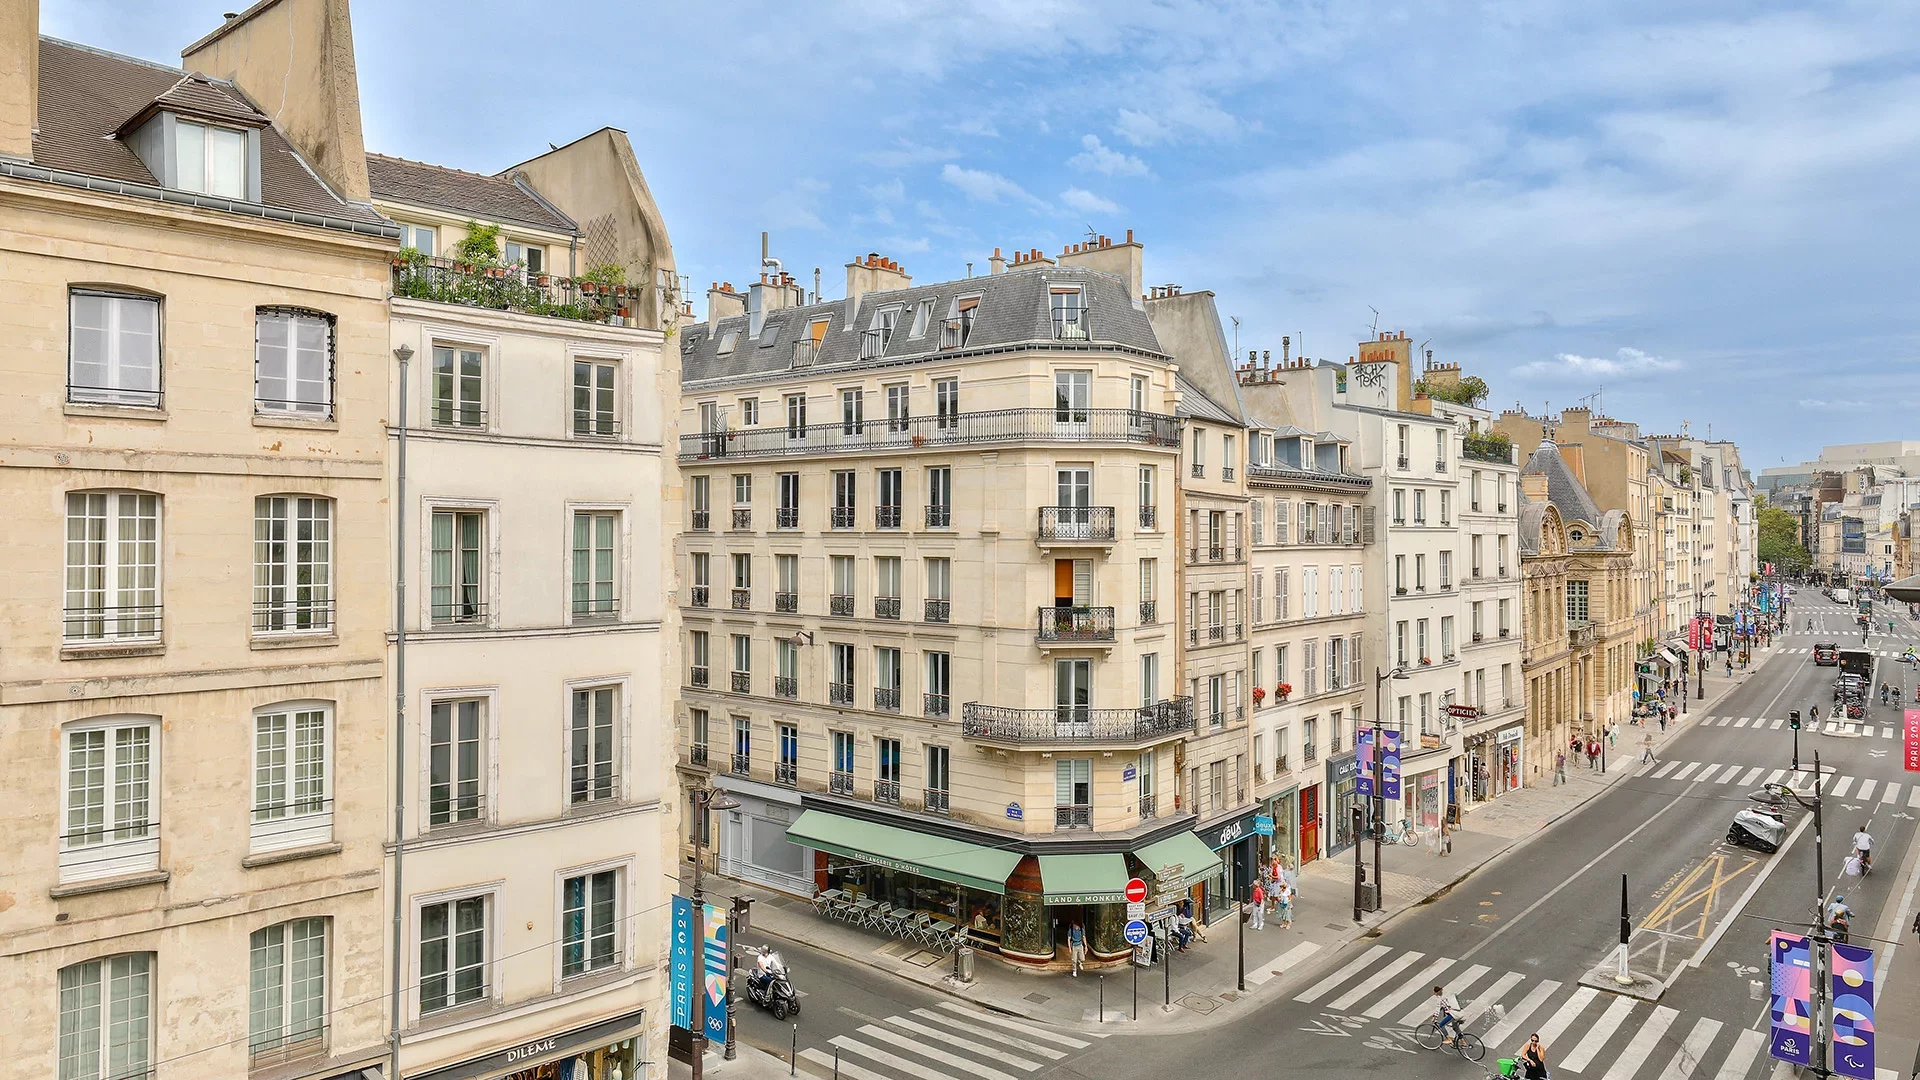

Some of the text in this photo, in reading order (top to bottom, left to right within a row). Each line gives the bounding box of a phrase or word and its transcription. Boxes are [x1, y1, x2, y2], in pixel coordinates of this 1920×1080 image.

[1447, 707, 1477, 717] OPTICIEN
[1910, 714, 1919, 768] PARIS 2024
[855, 853, 892, 867] BOULANGERIE
[677, 907, 687, 1017] PARIS 2024
[506, 1038, 557, 1062] DILEME
[1780, 1045, 1800, 1055] PARIS
